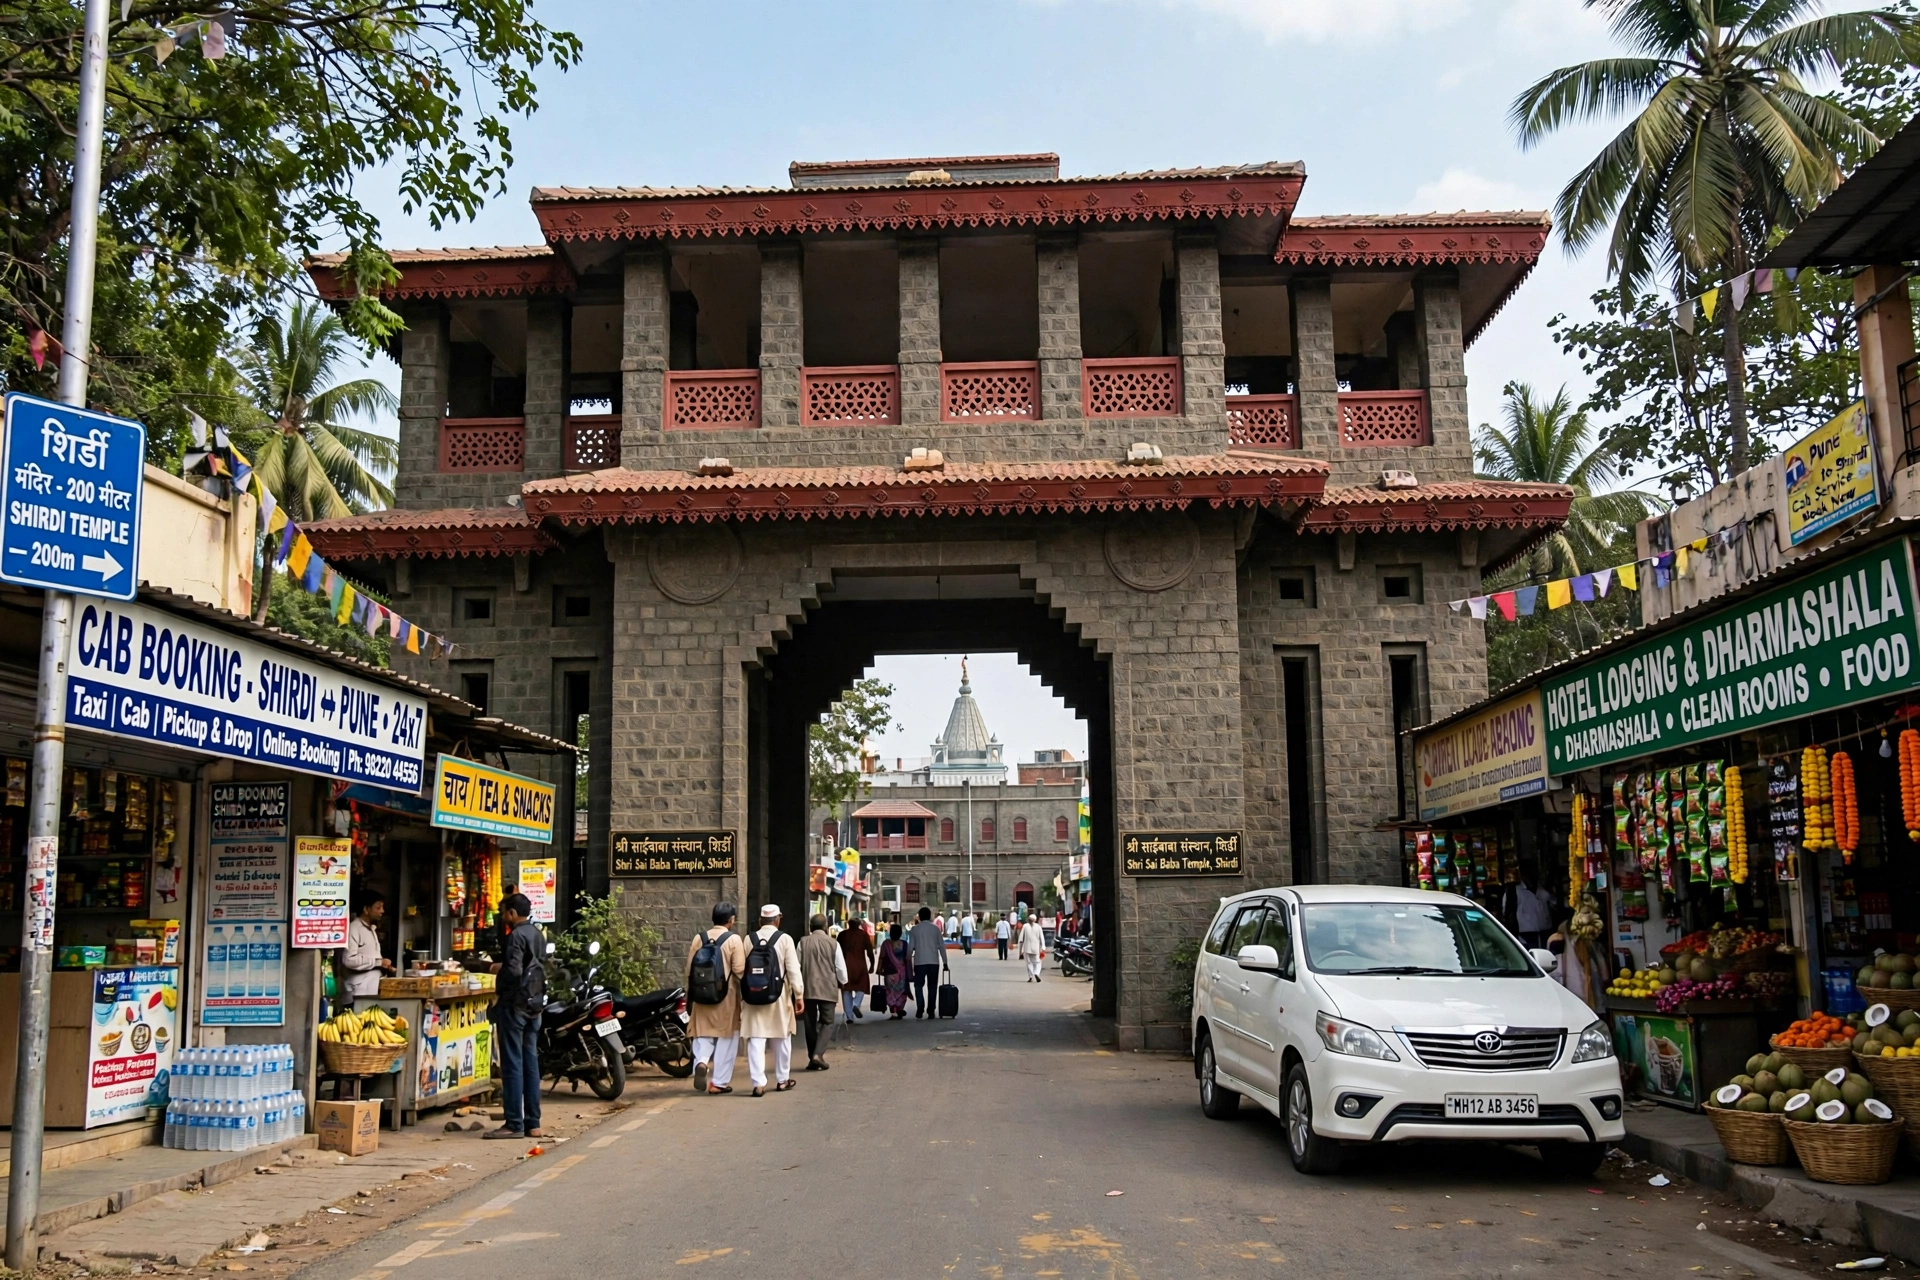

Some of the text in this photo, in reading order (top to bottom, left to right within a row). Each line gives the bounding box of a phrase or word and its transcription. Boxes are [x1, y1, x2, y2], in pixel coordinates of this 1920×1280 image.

[41, 417, 111, 470] शिर्डी
[14, 463, 53, 494] मंदिर
[66, 477, 95, 504] 200
[98, 480, 132, 511] मीटर
[10, 500, 130, 545] SHIRDI TEMPLE
[31, 541, 75, 571] 200m
[1547, 558, 1904, 731] HOTEL LODGING & DHARMASHALA
[78, 604, 134, 675] CAB
[139, 622, 242, 703] BOOKING
[258, 659, 317, 723] SHIRDI
[339, 685, 380, 739] PUNE
[391, 701, 424, 749] 24x7
[1565, 709, 1661, 763] DHARMASHALA
[1680, 685, 1735, 733] CLEAN
[1737, 663, 1810, 718] ROOMS
[1841, 632, 1910, 691] FOOD
[73, 684, 108, 721] Taxi
[120, 696, 150, 729] Cab
[162, 705, 208, 747] Pickup
[210, 716, 221, 744] &
[224, 719, 253, 755] Drop
[263, 729, 297, 759] Online
[299, 738, 340, 773] Booking
[348, 749, 363, 773] Ph:
[364, 752, 391, 779] 98220
[444, 771, 470, 808] चाय
[479, 778, 498, 814] TEA
[502, 784, 509, 816] &
[513, 786, 551, 824] SNACKS
[615, 858, 632, 870] Shri
[635, 858, 647, 870] Sai
[650, 857, 671, 870] Baba
[1127, 858, 1143, 869] Shri
[1145, 858, 1158, 869] Sai
[1160, 857, 1180, 869] Baba
[1454, 1098, 1535, 1114] MH12 AB 3456
